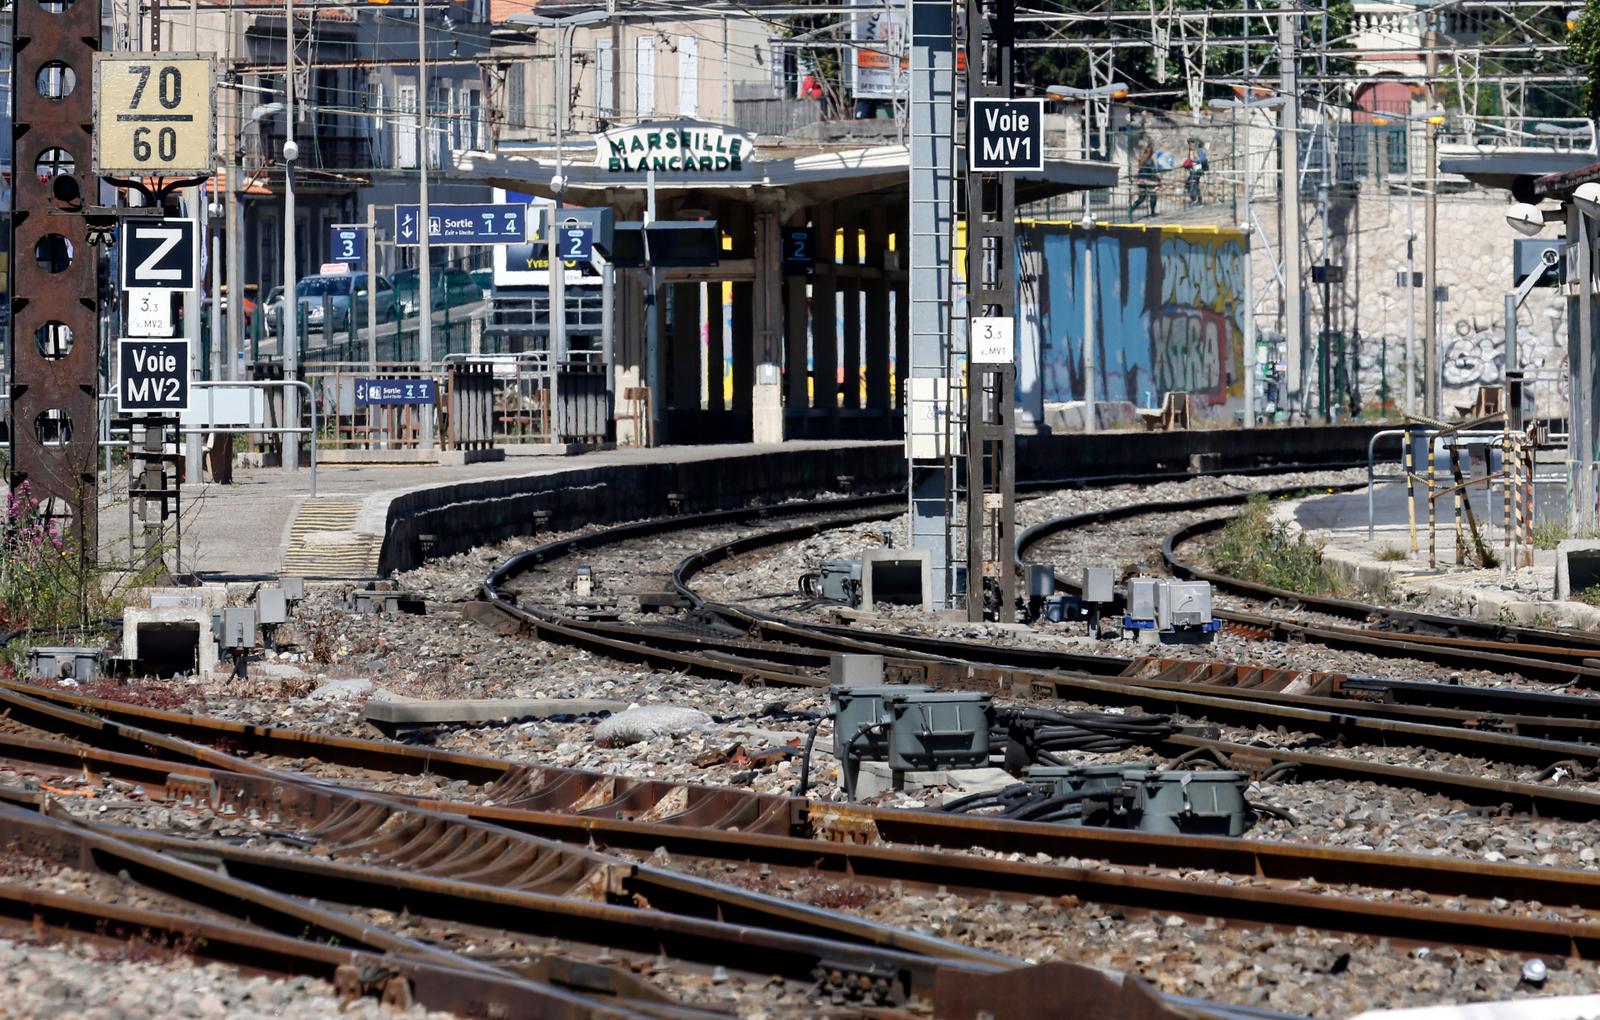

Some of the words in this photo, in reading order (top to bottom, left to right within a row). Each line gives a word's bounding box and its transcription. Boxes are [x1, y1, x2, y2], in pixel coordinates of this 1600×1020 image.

[128, 65, 182, 110] 70
[985, 108, 1030, 132] Voie
[133, 126, 177, 162] 60
[609, 128, 743, 157] MARSEILLE
[983, 136, 1031, 160] MV1
[608, 156, 743, 172] BLANCARDE
[444, 218, 474, 228] Sortie
[484, 220, 493, 233] 1
[505, 220, 517, 233] 4
[135, 228, 183, 280] Z
[342, 239, 354, 257] 3
[570, 238, 582, 255] 2
[793, 241, 805, 257] 2
[526, 258, 549, 268] YVES
[131, 348, 177, 373] Voie
[127, 377, 181, 402] MV2
